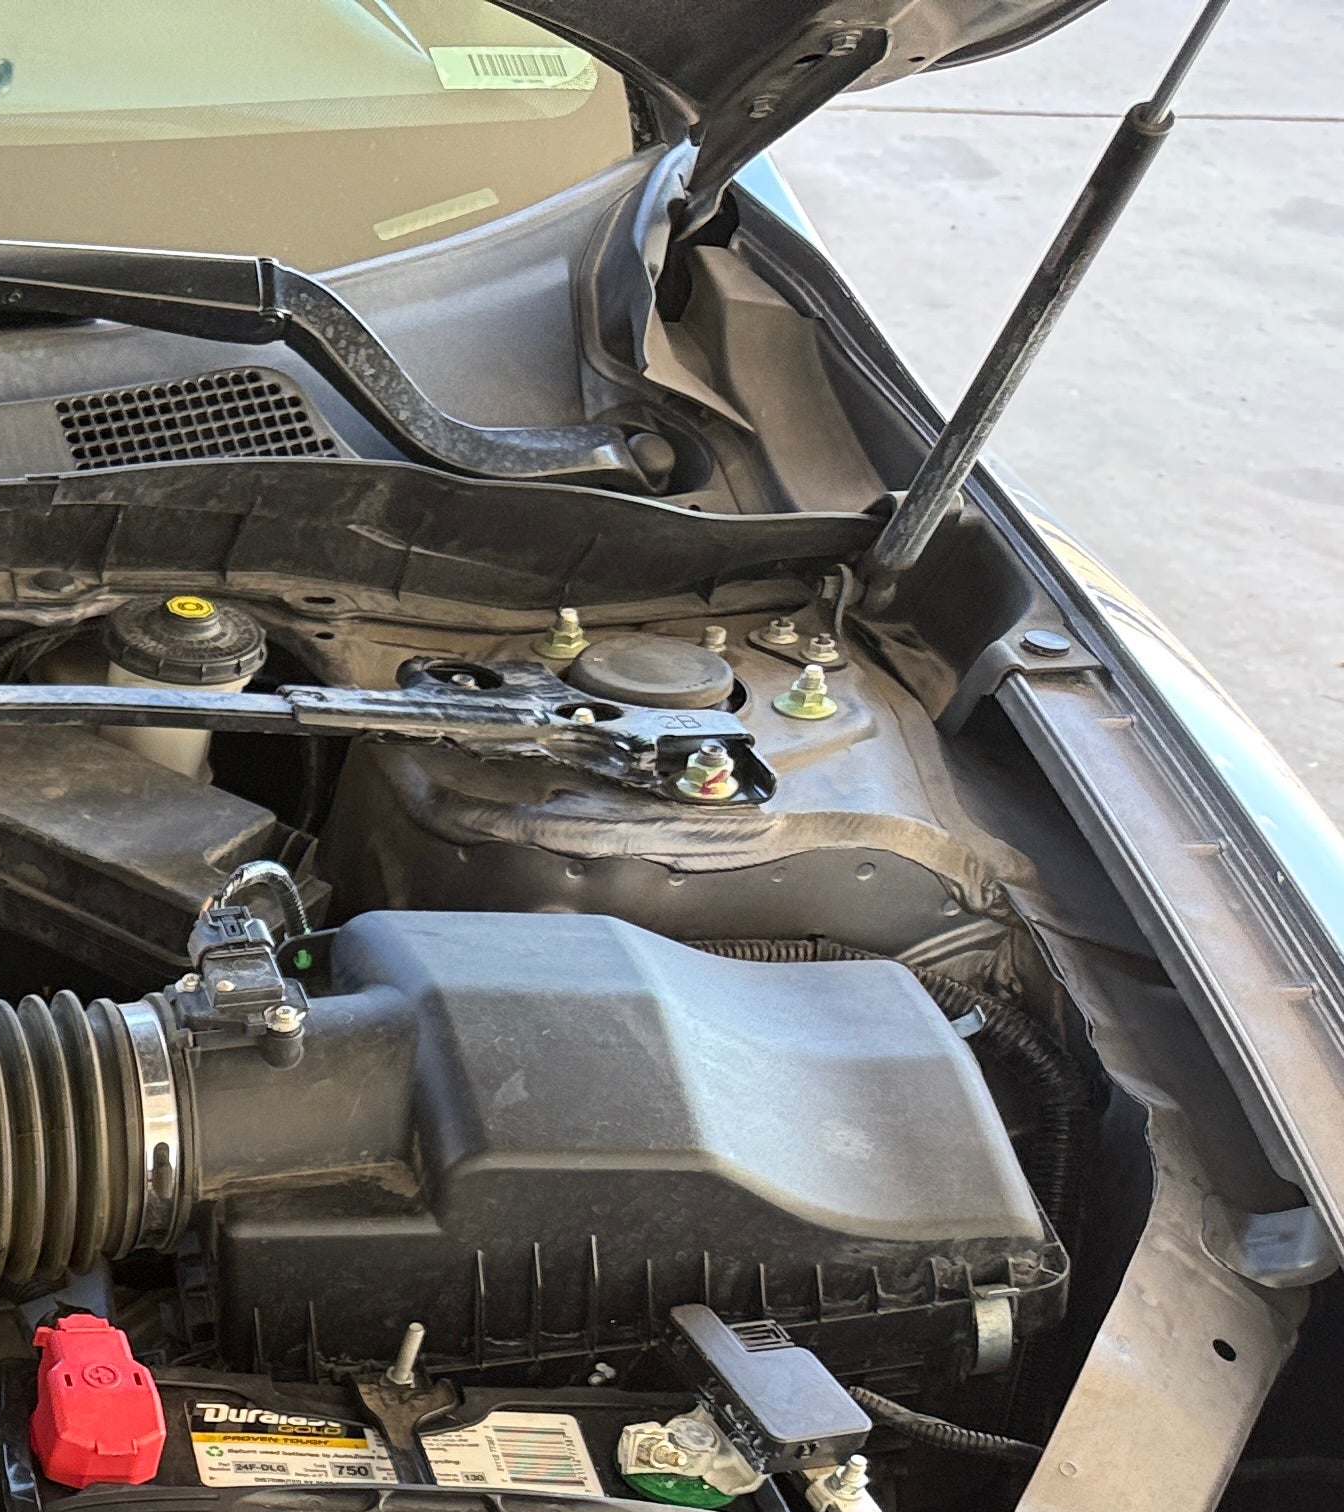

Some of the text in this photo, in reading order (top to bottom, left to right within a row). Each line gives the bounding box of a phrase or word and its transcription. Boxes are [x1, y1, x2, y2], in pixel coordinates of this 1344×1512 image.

[658, 714, 702, 729] 2B
[196, 1402, 341, 1427] Durala
[277, 1425, 341, 1436] GOLD
[223, 1435, 330, 1446] PROVEN TOUGH
[333, 1465, 369, 1477] 750
